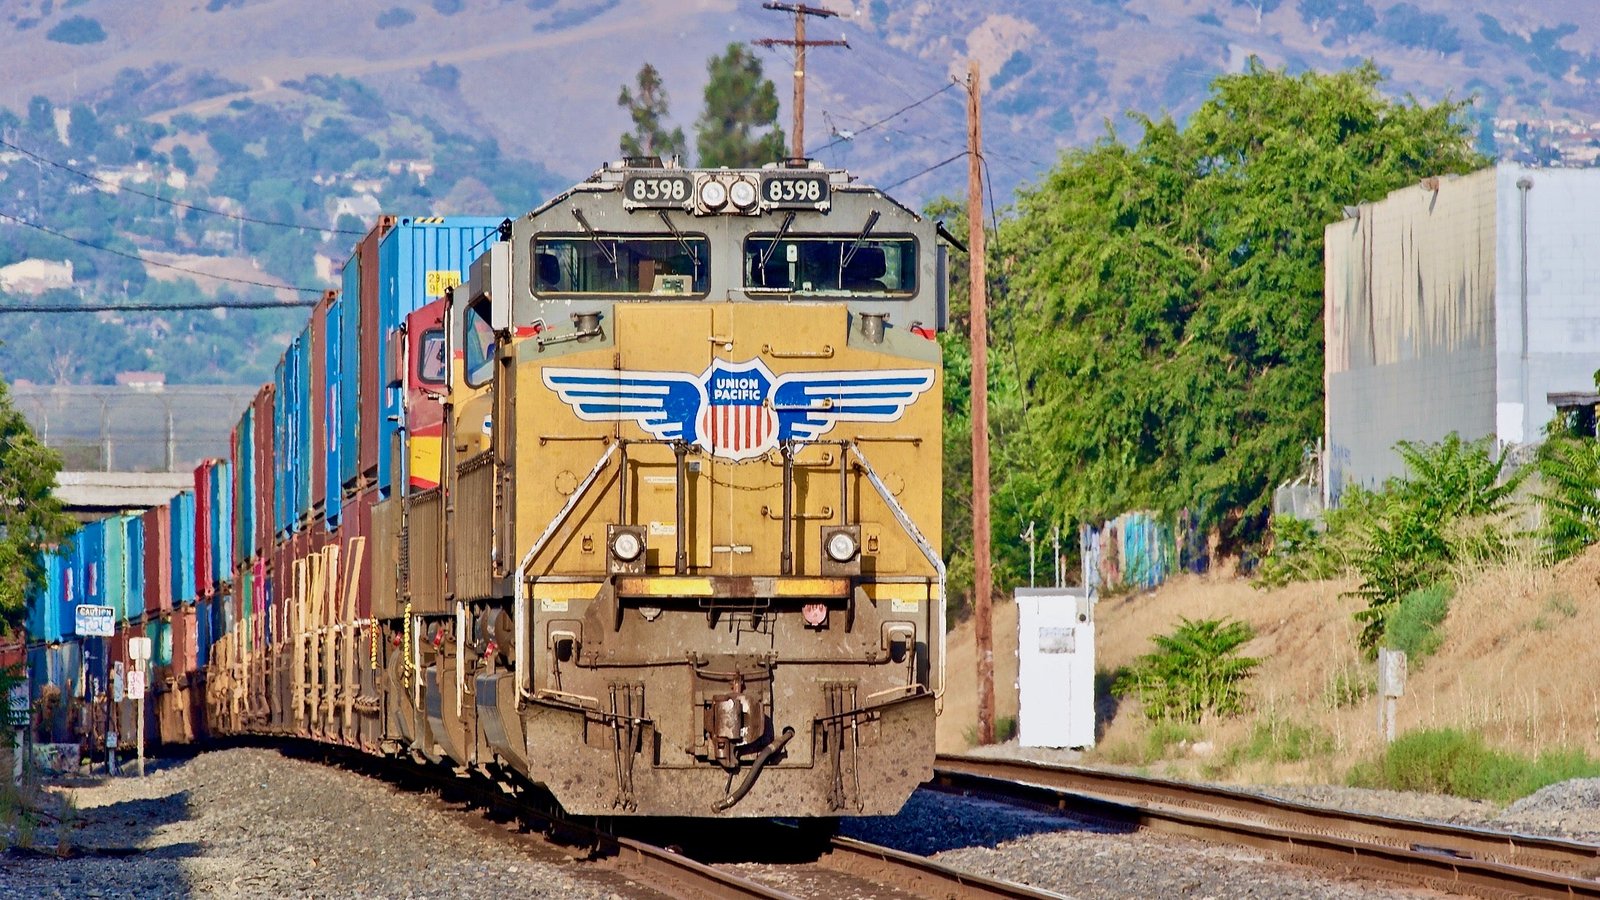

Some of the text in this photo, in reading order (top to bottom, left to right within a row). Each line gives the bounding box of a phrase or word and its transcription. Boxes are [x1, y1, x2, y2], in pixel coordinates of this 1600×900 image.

[633, 179, 685, 200] 8398
[769, 180, 821, 201] 8398
[716, 378, 759, 389] UNION
[714, 389, 761, 400] PACIFIC
[80, 607, 112, 617] CAUTION
